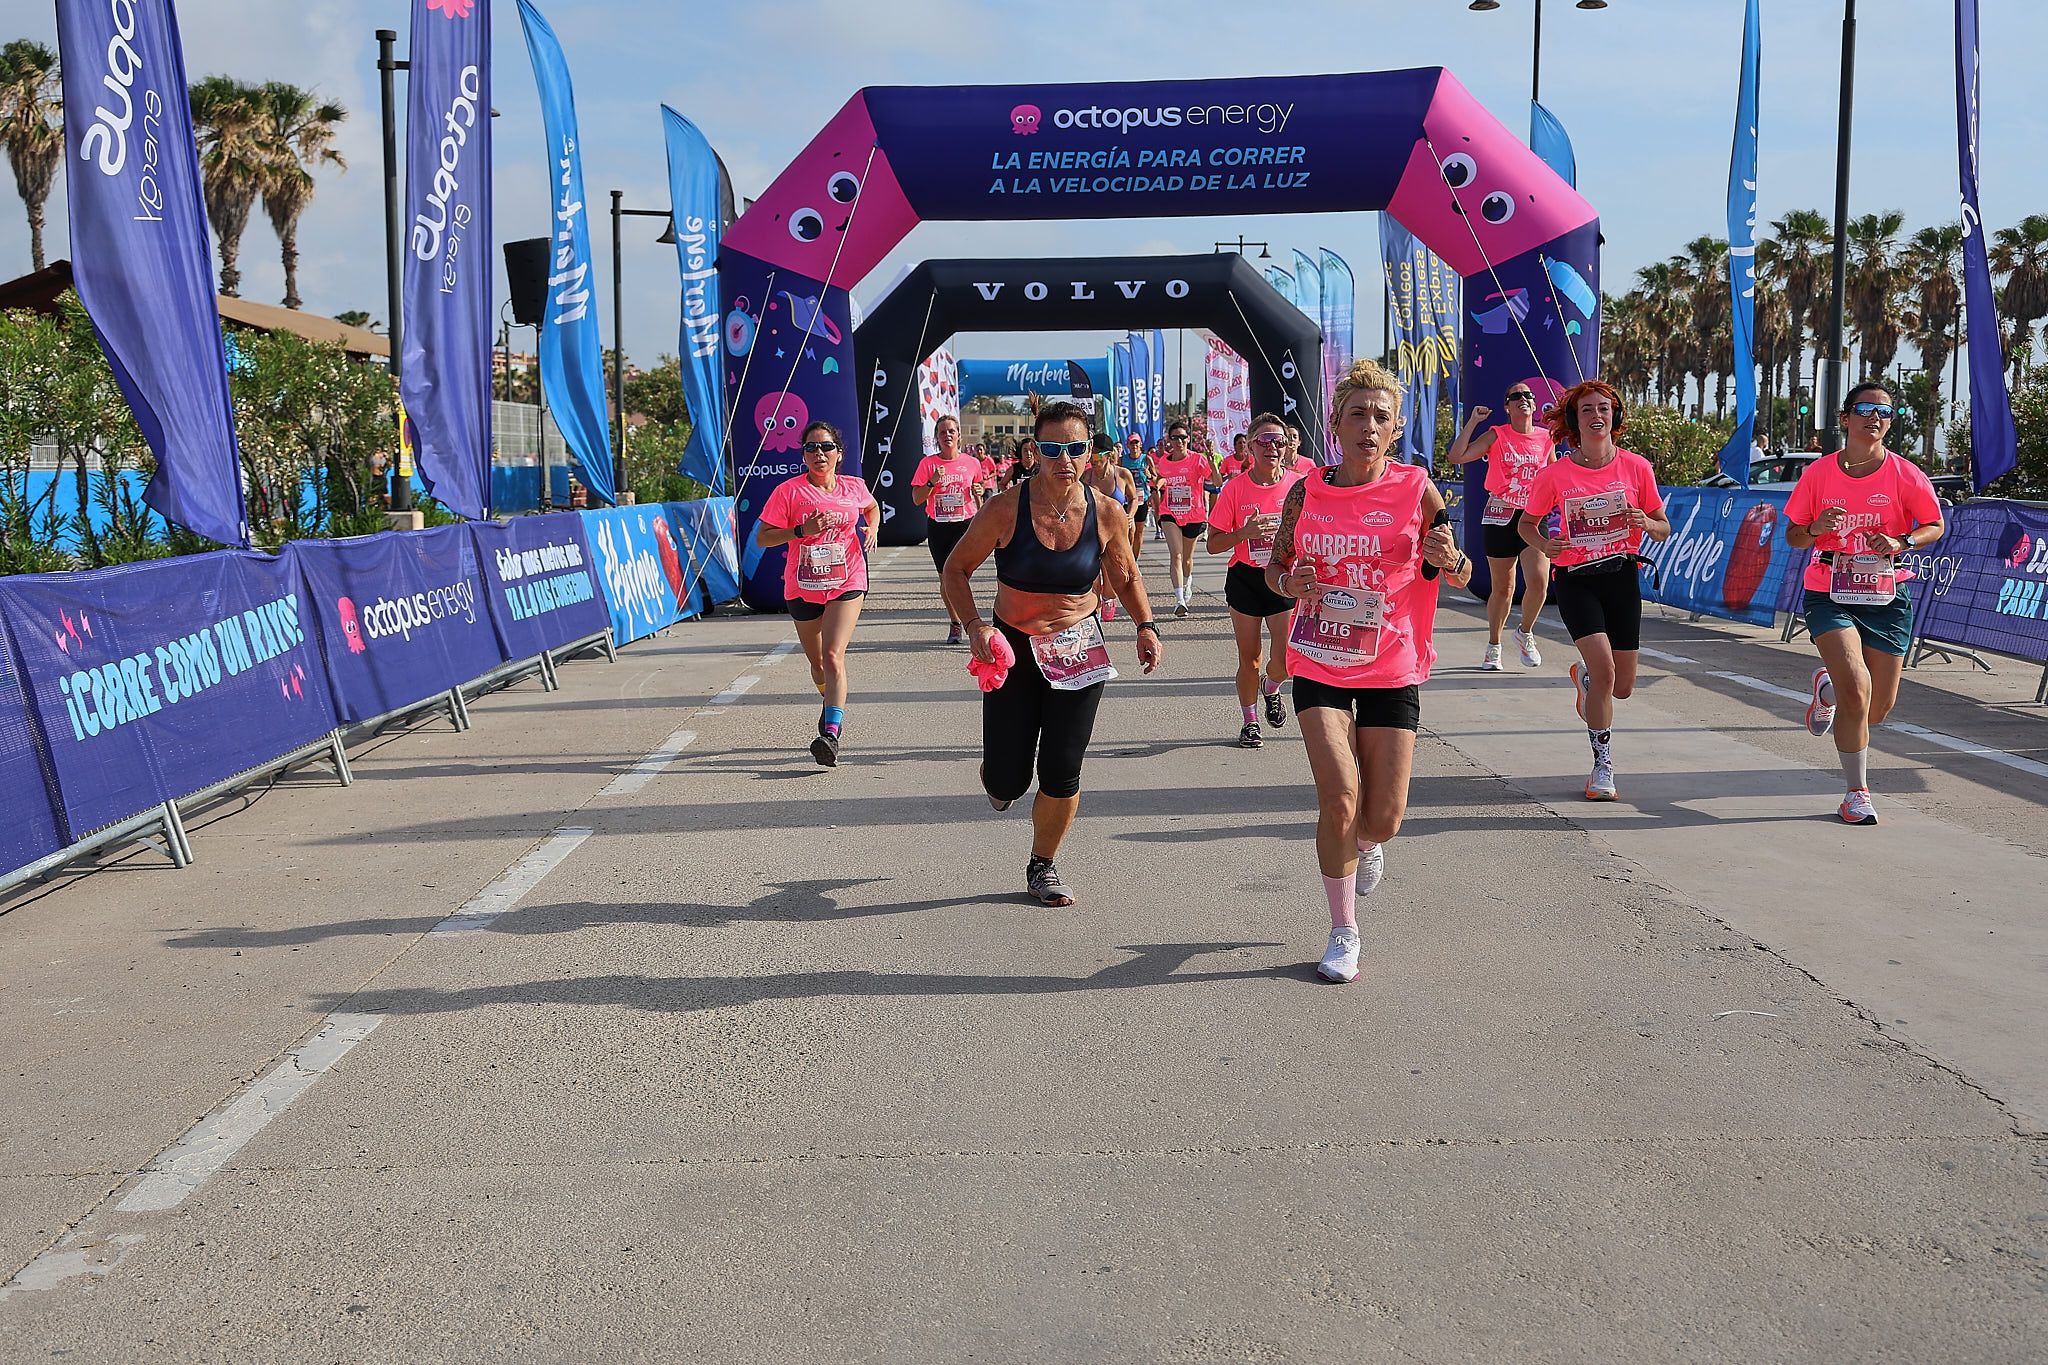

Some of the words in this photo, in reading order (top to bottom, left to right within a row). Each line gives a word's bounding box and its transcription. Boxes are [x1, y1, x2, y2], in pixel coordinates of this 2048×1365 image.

[1053, 105, 1183, 135] octopus
[1186, 103, 1295, 134] energy
[991, 151, 1022, 170] LA
[1027, 145, 1131, 170] ENERGÍA
[1137, 148, 1202, 169] PARA
[1208, 145, 1307, 167] CORRER
[988, 178, 1006, 194] A
[1012, 177, 1042, 194] LA
[1050, 174, 1185, 194] VELOCIDAD
[1189, 174, 1220, 191] DE
[1226, 173, 1258, 190] LA
[1262, 171, 1311, 189] LUZ
[972, 278, 1190, 301] VOLVO
[1006, 362, 1070, 391] Marlene
[873, 368, 897, 524] VOLVO
[738, 463, 789, 479] octopus
[1821, 498, 1847, 506] OYSHO
[1586, 517, 1610, 527] 016
[1838, 513, 1882, 530] RRERA
[1302, 533, 1382, 557] CARRERA
[1639, 492, 1724, 600] arlene
[495, 547, 523, 581] Solo
[521, 549, 543, 576] unos
[539, 541, 569, 572] metros
[563, 537, 583, 567] más
[811, 566, 832, 575] 016
[1852, 573, 1879, 584] 016
[1901, 553, 1963, 596] energy
[504, 587, 525, 621] YA
[518, 583, 540, 618] LO
[533, 579, 555, 613] HAS
[1323, 596, 1356, 607] ASTURIANA
[1996, 578, 2046, 619] PARA
[364, 590, 431, 642] octopus
[429, 579, 477, 624] energy
[1319, 620, 1351, 637] 016
[1297, 647, 1323, 659] OYSHO
[1298, 639, 1317, 647] CARRERA
[155, 628, 222, 704] COMO
[214, 615, 253, 677] UN
[1062, 651, 1089, 667] 016
